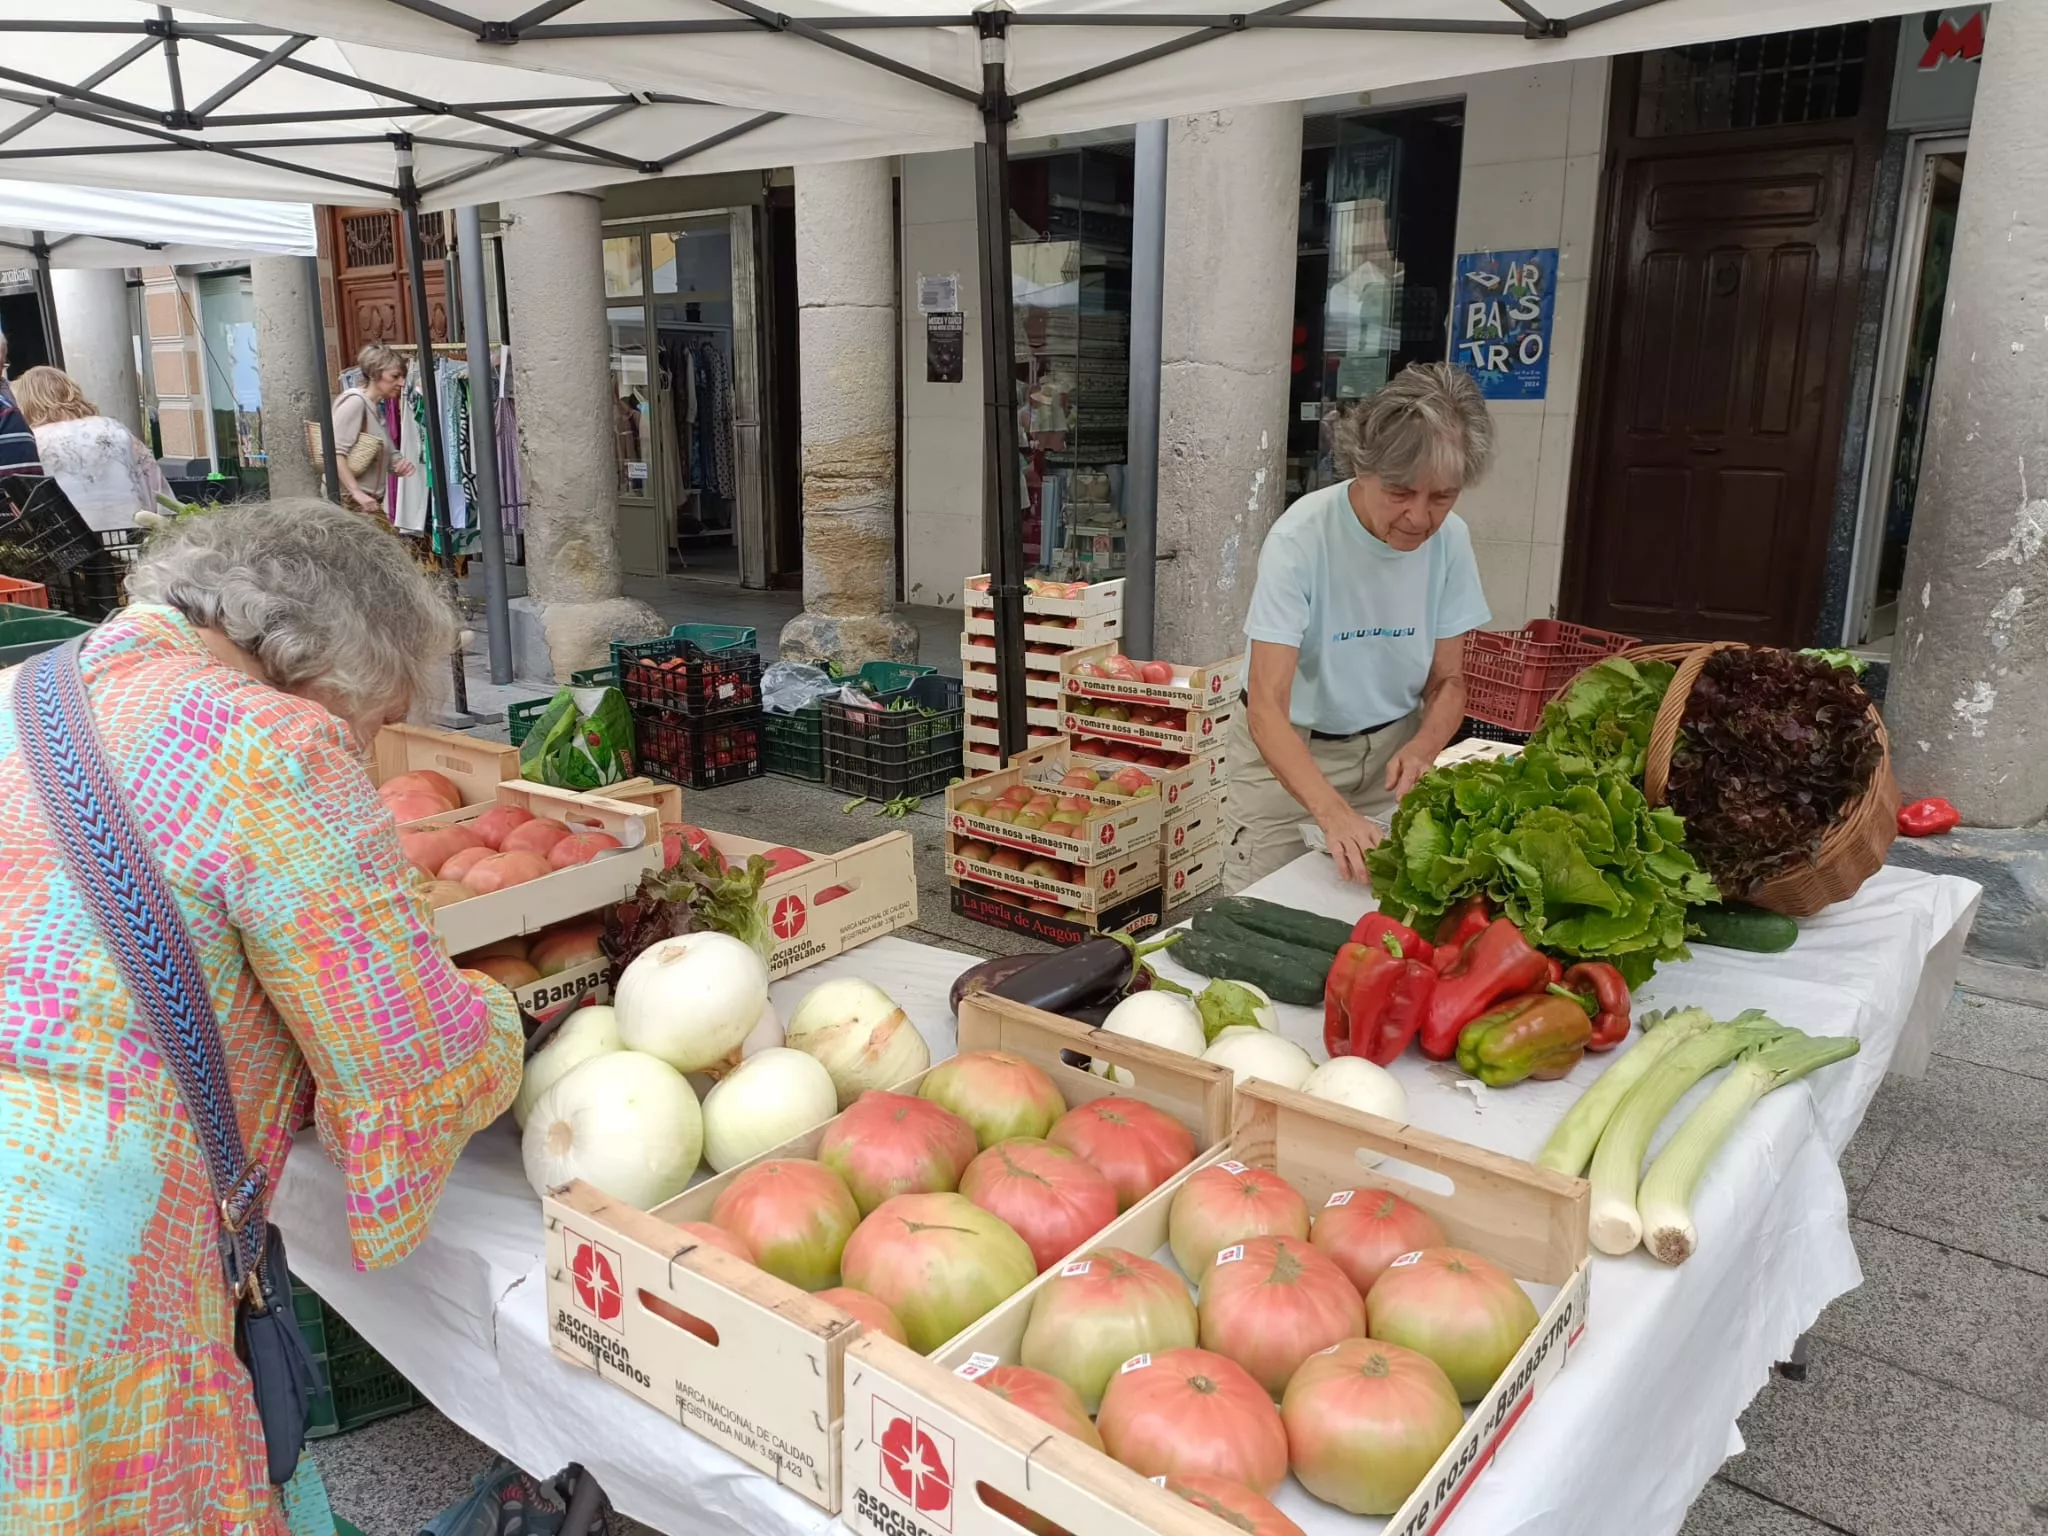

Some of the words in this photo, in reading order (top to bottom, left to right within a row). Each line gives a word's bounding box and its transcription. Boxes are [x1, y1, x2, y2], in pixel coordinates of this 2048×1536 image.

[968, 819, 1000, 834] TOMATE
[1002, 828, 1023, 839] ROSA
[1031, 834, 1079, 853] BARBASTRO
[970, 864, 1002, 878] TOMATE
[1004, 872, 1025, 885] ROSA
[1033, 879, 1082, 899] BARBASTRO
[962, 894, 979, 911] La
[980, 900, 1011, 921] perla
[1014, 911, 1029, 928] de
[1032, 919, 1081, 943] Aragón
[770, 939, 812, 962] ociación
[559, 1309, 629, 1362] asociación
[675, 1395, 733, 1437] REGISTRADA
[675, 1379, 706, 1406] MARCA
[708, 1398, 755, 1433] NACIONAL
[756, 1426, 770, 1442] DE
[772, 1435, 814, 1468] CALIDAD
[1434, 1433, 1479, 1509] ROSA
[1494, 1302, 1572, 1429] BARBASTRO
